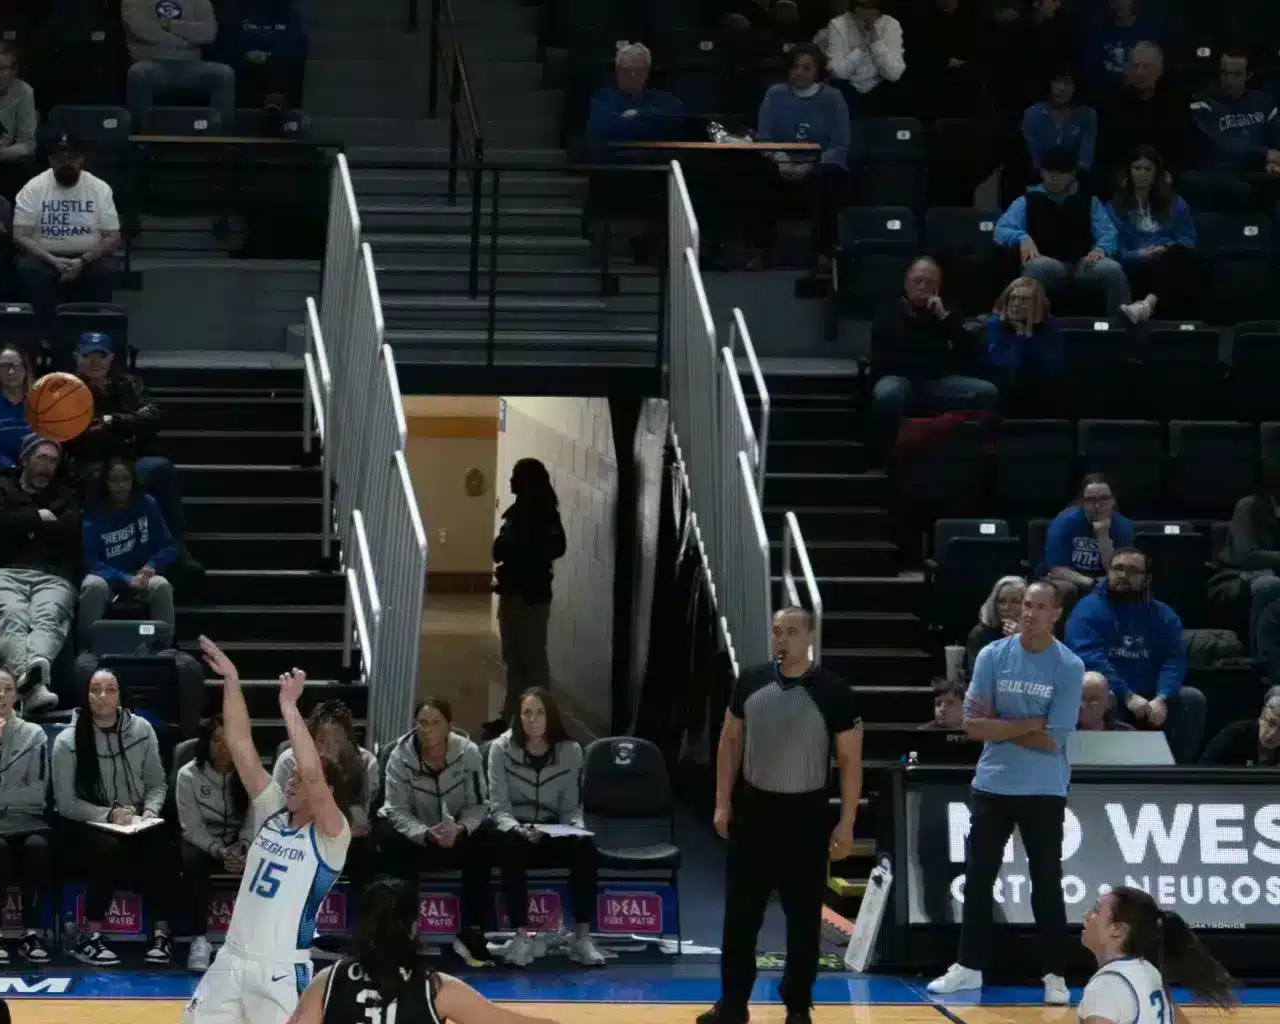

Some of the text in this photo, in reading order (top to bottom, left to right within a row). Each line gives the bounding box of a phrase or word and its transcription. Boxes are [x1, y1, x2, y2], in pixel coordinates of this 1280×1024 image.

[41, 200, 94, 213] HUSTLE
[40, 213, 70, 225] LIKE
[254, 835, 307, 862] CREIGHTON
[248, 857, 289, 899] 15
[606, 898, 652, 915] IDEAL
[427, 918, 453, 928] WATER
[629, 916, 656, 926] WATER
